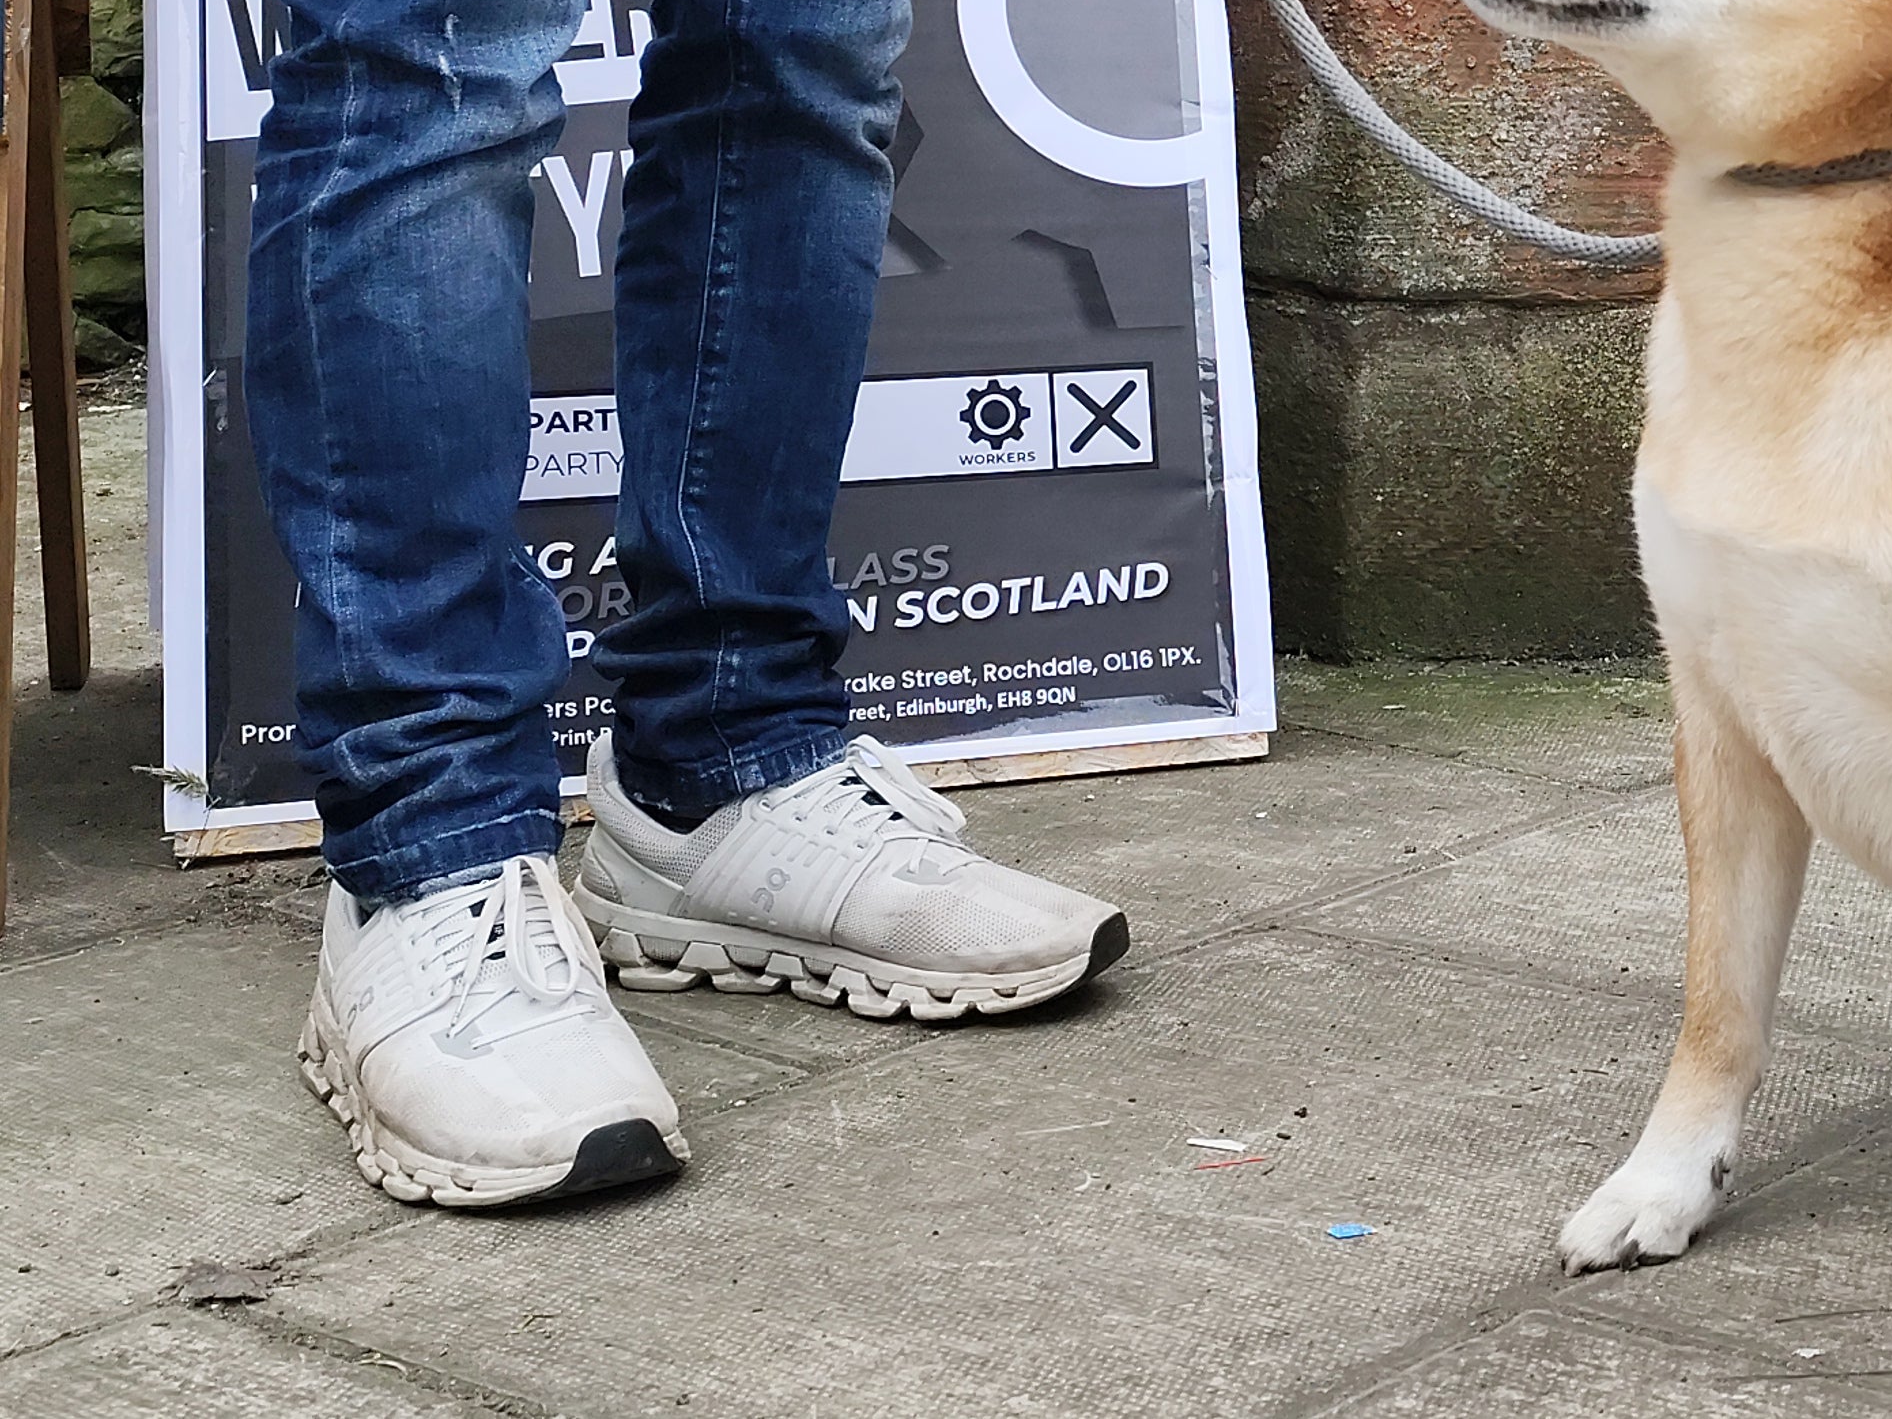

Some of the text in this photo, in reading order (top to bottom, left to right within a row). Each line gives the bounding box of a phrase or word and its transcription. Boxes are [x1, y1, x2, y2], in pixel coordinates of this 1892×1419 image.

[959, 451, 1036, 466] WORKERS
[894, 561, 1170, 629] SCOTLAND
[902, 662, 977, 689] Street,
[982, 654, 1098, 683] Rochdale,
[1102, 649, 1153, 673] OL16
[1158, 646, 1202, 668] 1PX.
[896, 690, 993, 719] Edinburgh,
[997, 688, 1033, 709] EH8
[1035, 685, 1077, 706] 9QN
